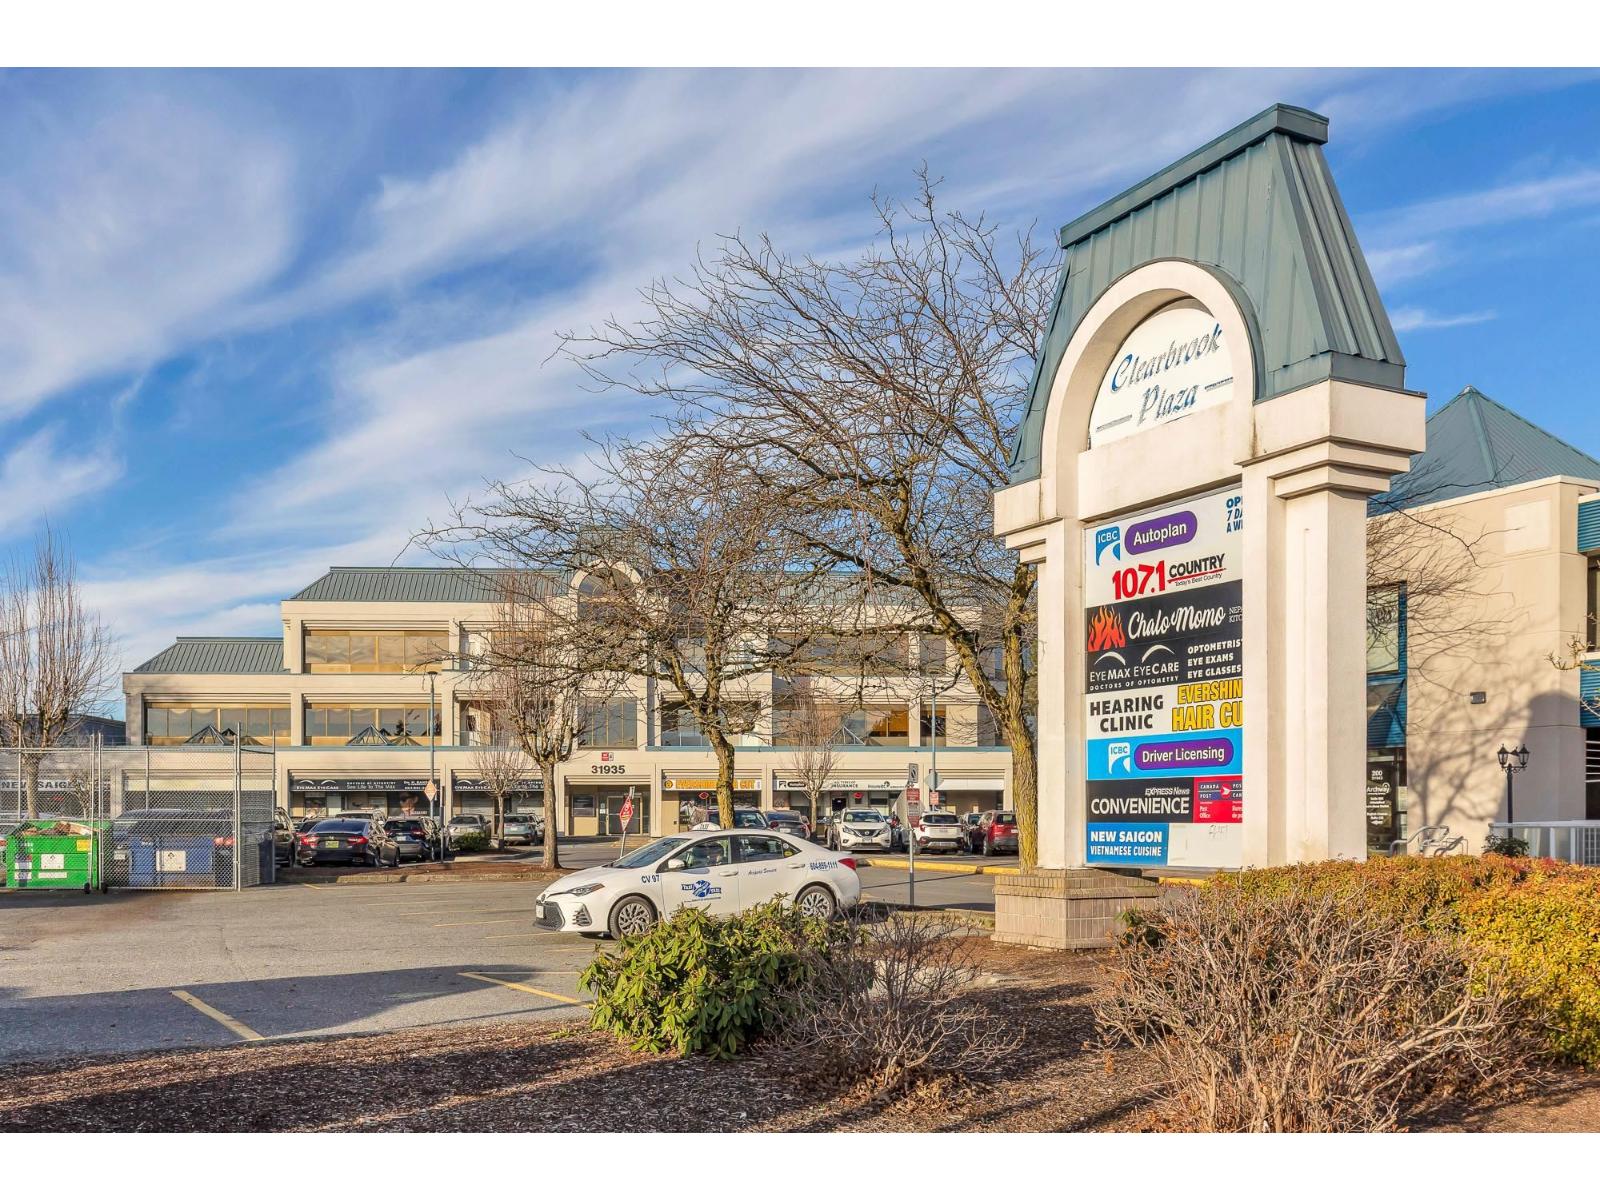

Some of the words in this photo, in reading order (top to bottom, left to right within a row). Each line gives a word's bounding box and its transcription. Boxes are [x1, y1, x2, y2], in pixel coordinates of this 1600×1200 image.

[1111, 323, 1222, 393] Clearbrook
[1138, 384, 1199, 425] Plaza
[1226, 496, 1243, 508] OP
[1227, 509, 1233, 521] 7
[1133, 523, 1187, 546] Autoplan
[1227, 522, 1232, 533] A
[1098, 530, 1118, 543] ICBC
[1112, 560, 1166, 600] 107.1
[1169, 553, 1225, 578] COUNTRY
[1127, 609, 1170, 640] Chalo
[1170, 605, 1226, 632] Momo
[1187, 657, 1203, 667] EYE
[1205, 652, 1234, 665] EXAMS
[1090, 668, 1131, 682] EYEMAX
[1133, 661, 1180, 677] EYECARE
[1187, 669, 1203, 679] EYE
[1205, 664, 1242, 677] GLASSES
[1089, 682, 1122, 691] DOCTORS
[1137, 675, 1179, 685] OPTOMETRY
[1178, 678, 1243, 705] EVERSHIN
[1090, 694, 1164, 716] HEARING
[1100, 713, 1153, 733] CLINIC
[1172, 703, 1214, 732] HAIR
[1110, 746, 1128, 755] ICBC
[1142, 750, 1173, 763] Driver
[1175, 746, 1225, 762] Licensing
[591, 765, 626, 774] 31935
[1145, 787, 1173, 796] EXPRESS
[1173, 787, 1190, 795] News
[1091, 797, 1190, 815] CONVENIENCE
[1090, 831, 1116, 842] NEW
[1119, 831, 1162, 842] SAIGON
[1090, 845, 1132, 856] VIETNAMESE
[1133, 847, 1162, 857] CUISINE
[641, 875, 651, 884] CV
[652, 875, 660, 883] 97
